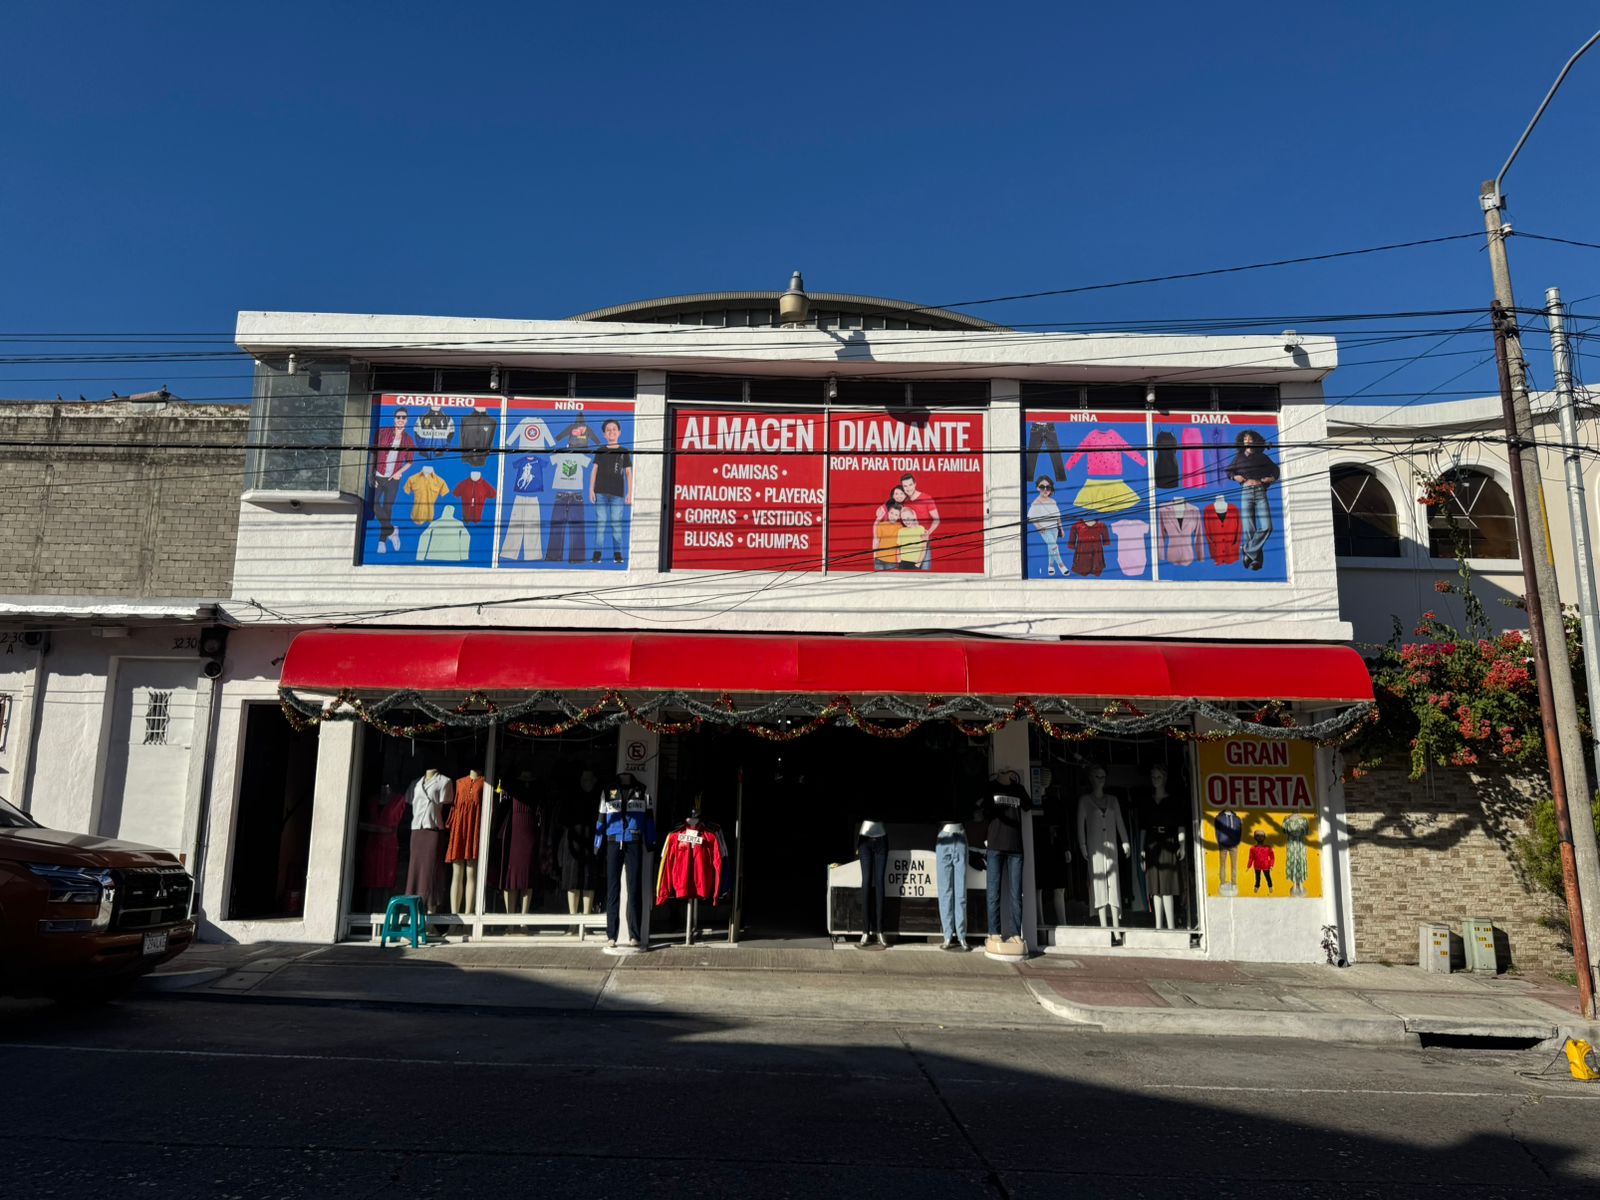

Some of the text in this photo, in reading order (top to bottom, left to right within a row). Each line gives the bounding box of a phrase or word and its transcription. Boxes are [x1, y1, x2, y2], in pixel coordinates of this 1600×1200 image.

[396, 395, 476, 408] CABALLERO
[555, 400, 584, 411] NIÑO
[1070, 412, 1098, 422] NIÑA
[1191, 413, 1231, 424] DAMA
[681, 416, 971, 452] ALMACEN DIAMANTE
[722, 464, 778, 480] CAMISAS
[830, 456, 980, 472] ROPA PARA TODA LA FAMILIA
[674, 484, 824, 504] PANTALONES PLAYERAS
[685, 508, 813, 526] GORRAS VESTIDOS
[684, 531, 809, 550] BLUSAS CHUMPAS
[1226, 741, 1289, 766] GRAN
[1208, 776, 1312, 807] OFERTA
[894, 860, 925, 871] GRAN
[888, 873, 932, 885] OFERTA
